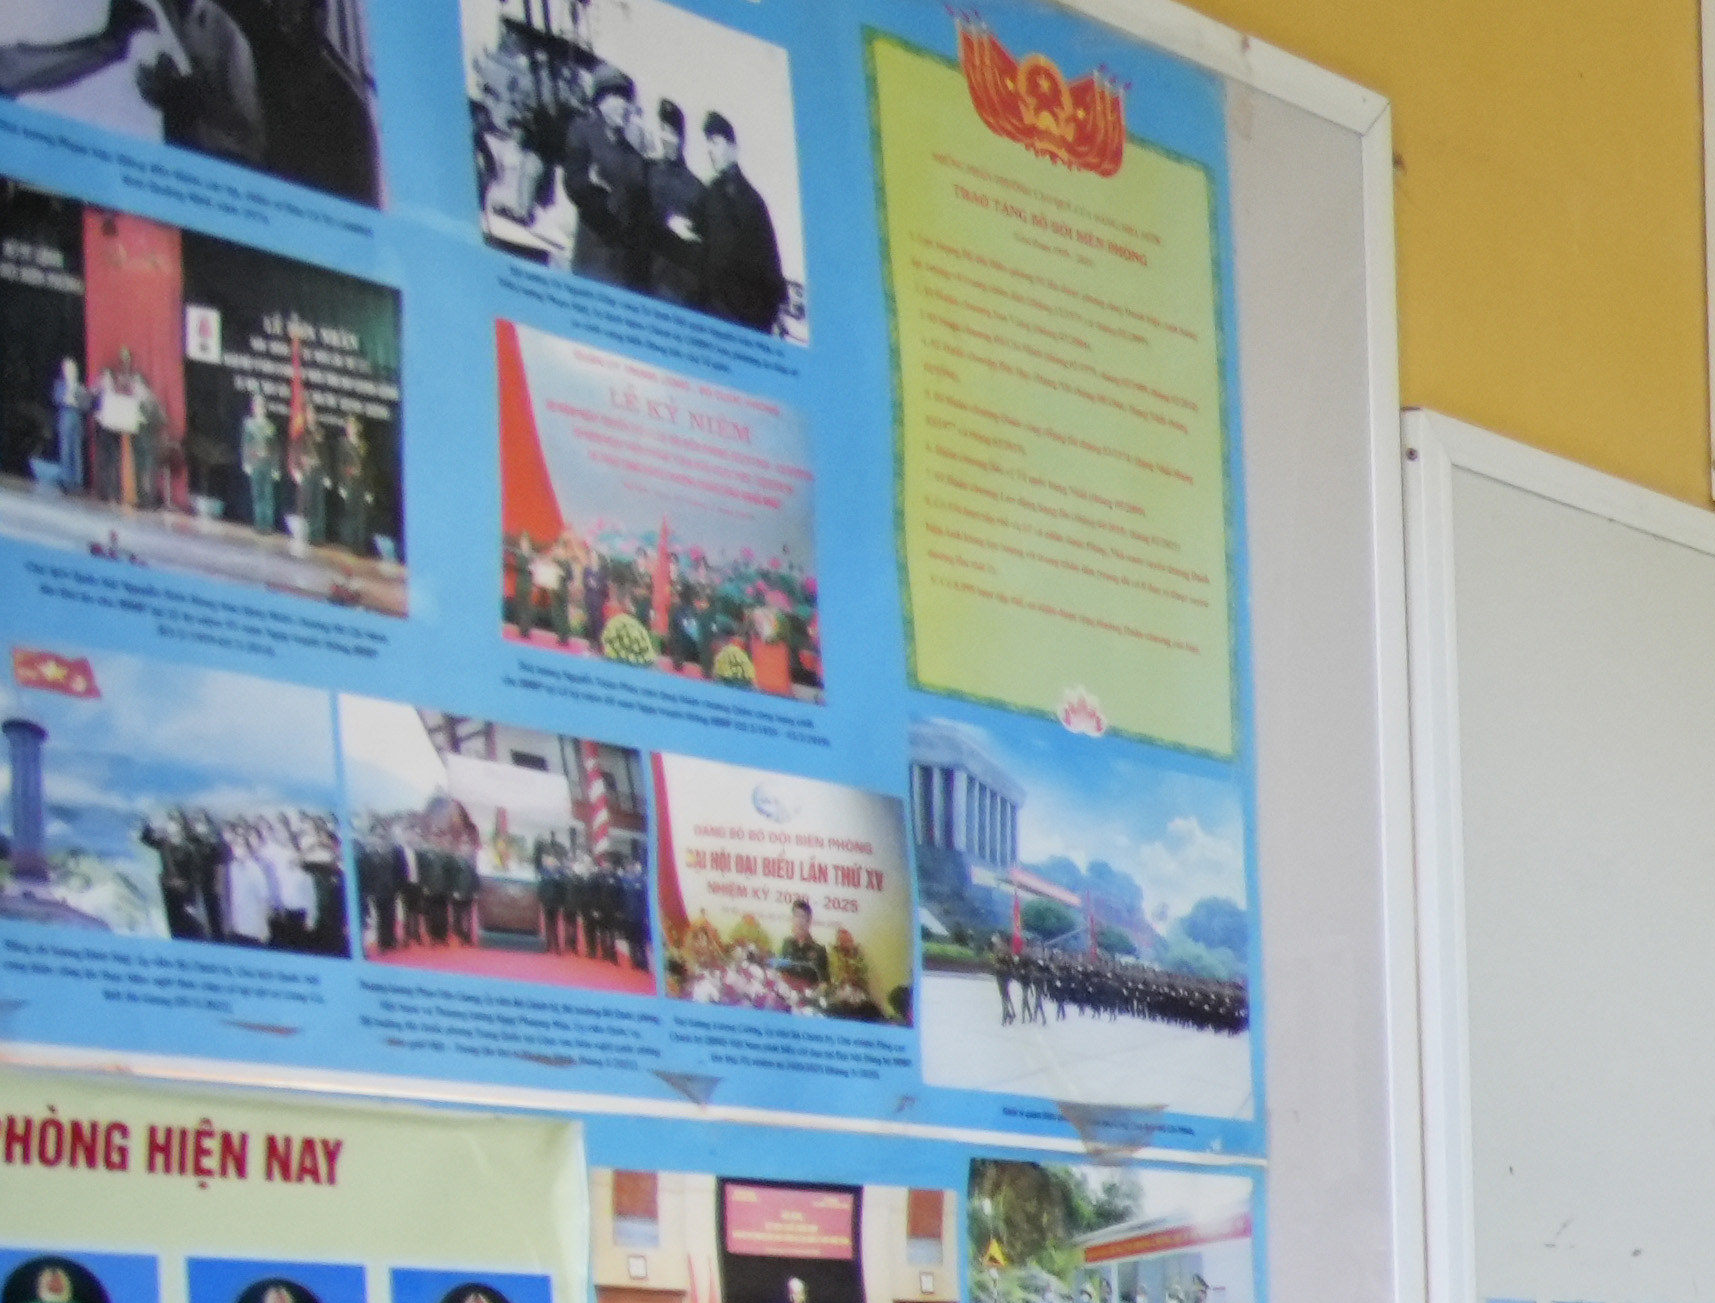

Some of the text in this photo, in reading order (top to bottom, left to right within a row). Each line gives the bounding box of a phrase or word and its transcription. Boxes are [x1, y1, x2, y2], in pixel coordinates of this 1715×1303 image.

[0, 1104, 343, 1190] HÒNG HIỆN NAY
